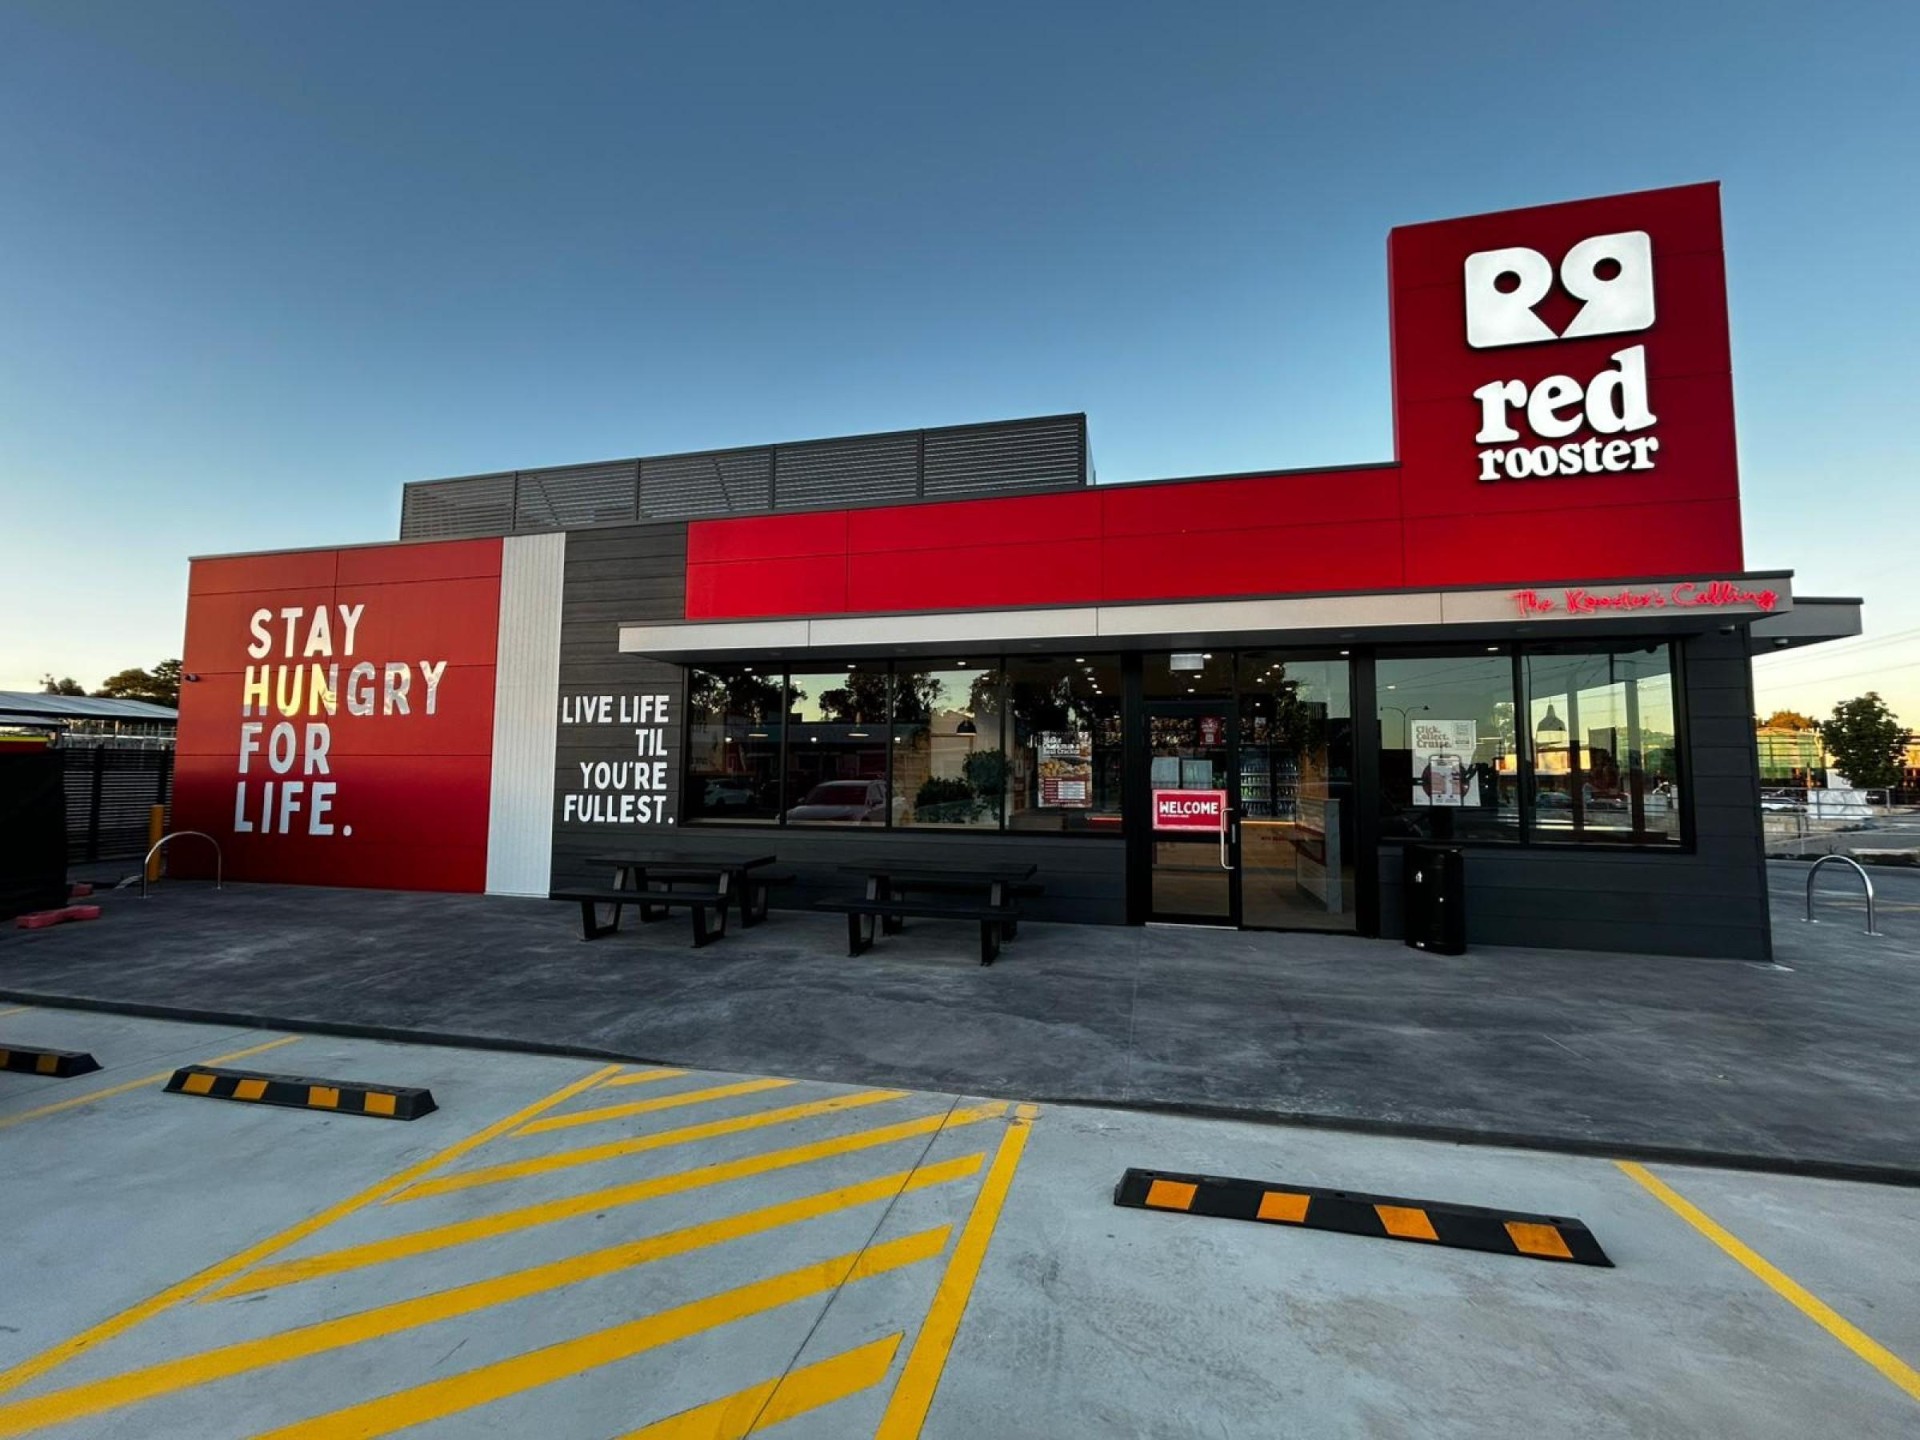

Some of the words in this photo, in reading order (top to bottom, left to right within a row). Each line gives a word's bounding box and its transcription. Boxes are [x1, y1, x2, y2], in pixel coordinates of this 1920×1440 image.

[1473, 344, 1657, 443] red
[1478, 433, 1660, 482] rooster
[1512, 587, 1555, 618] The
[1671, 579, 1778, 612] Calling
[247, 604, 365, 659] STAY
[243, 660, 448, 717] HUNGRY
[562, 695, 613, 723] LIVE
[619, 695, 670, 723] LIFE
[238, 722, 331, 775] FOR
[635, 728, 668, 757] TIL
[580, 761, 668, 790] YOU'RE
[234, 780, 353, 837] LIFE.
[563, 794, 675, 825] FULLEST.
[1159, 801, 1219, 815] WELCOME
